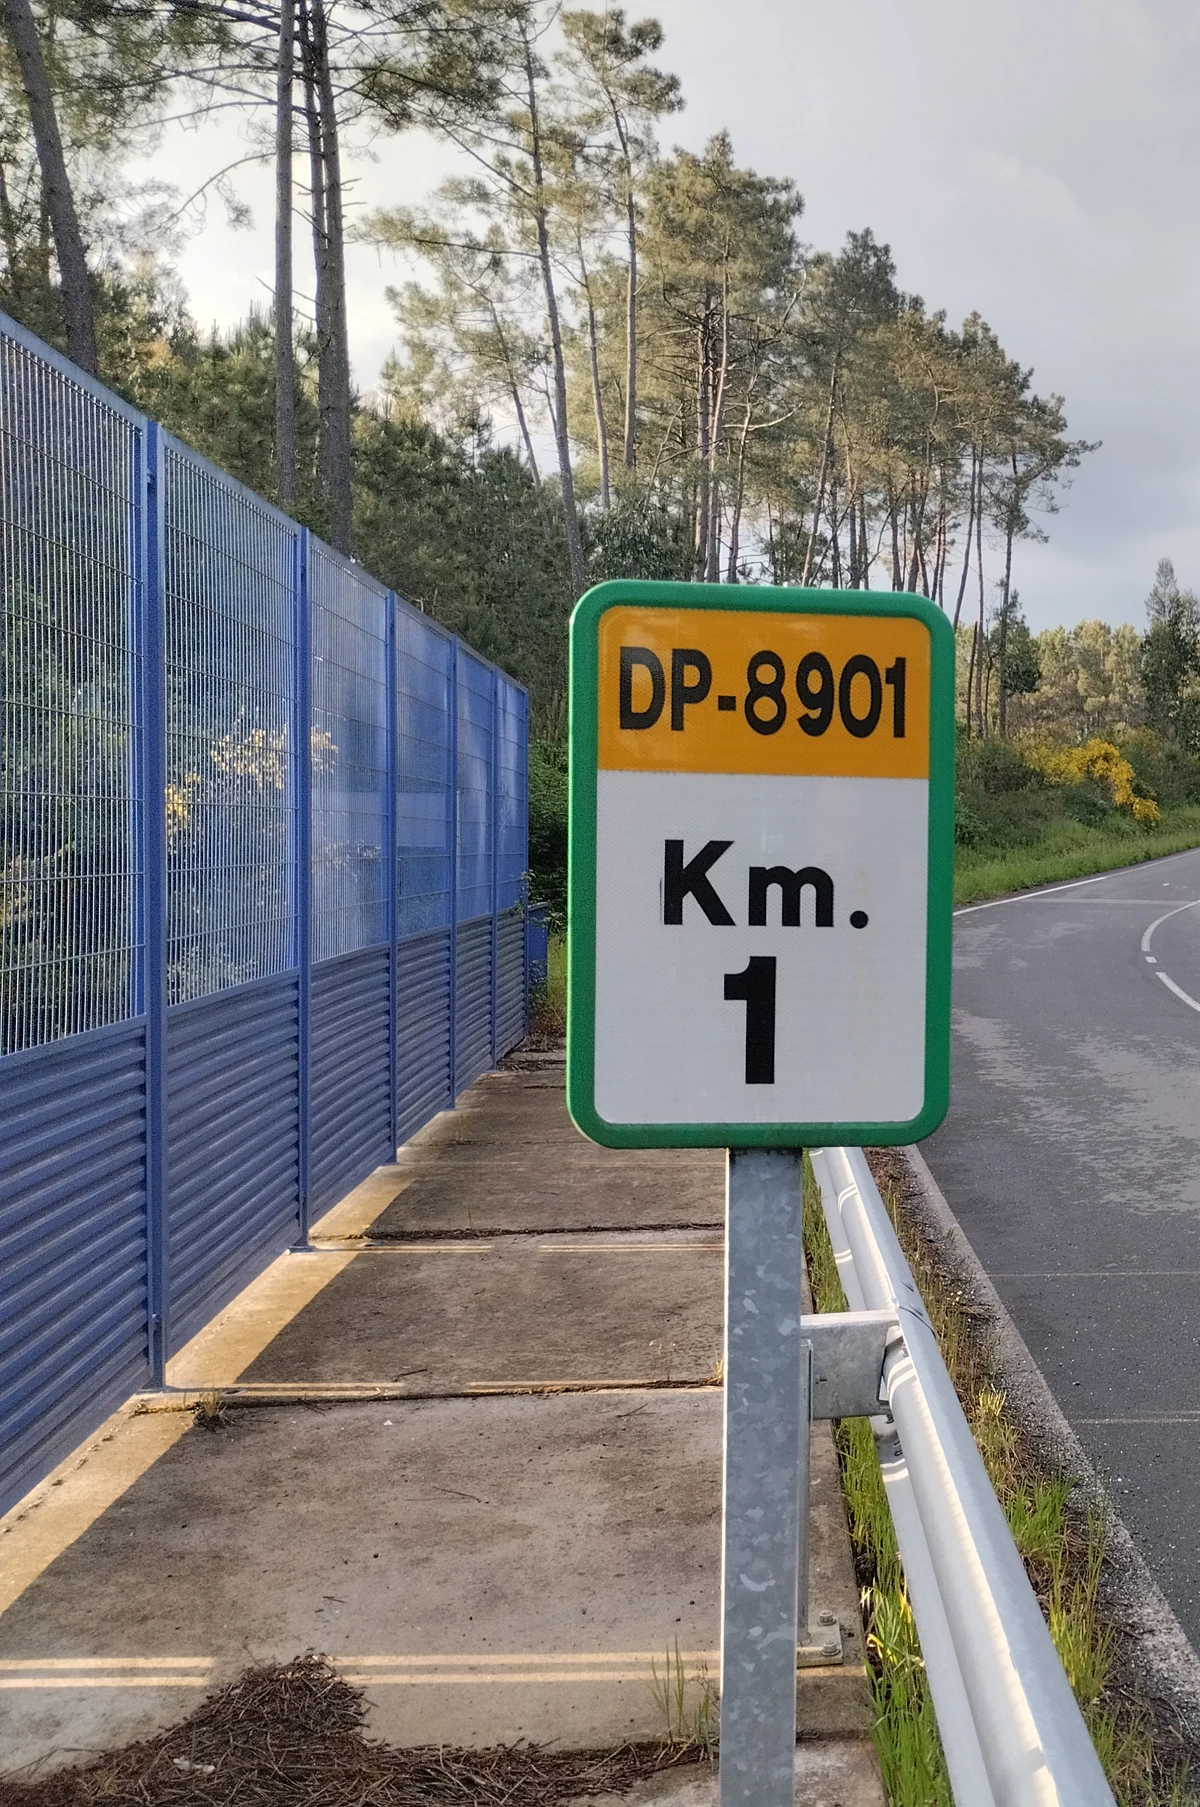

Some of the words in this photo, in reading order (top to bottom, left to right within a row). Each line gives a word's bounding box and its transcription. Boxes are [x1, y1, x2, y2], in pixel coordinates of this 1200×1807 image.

[619, 646, 906, 738] DP-8901
[663, 839, 869, 929] Km.
[724, 956, 776, 1084] 1
